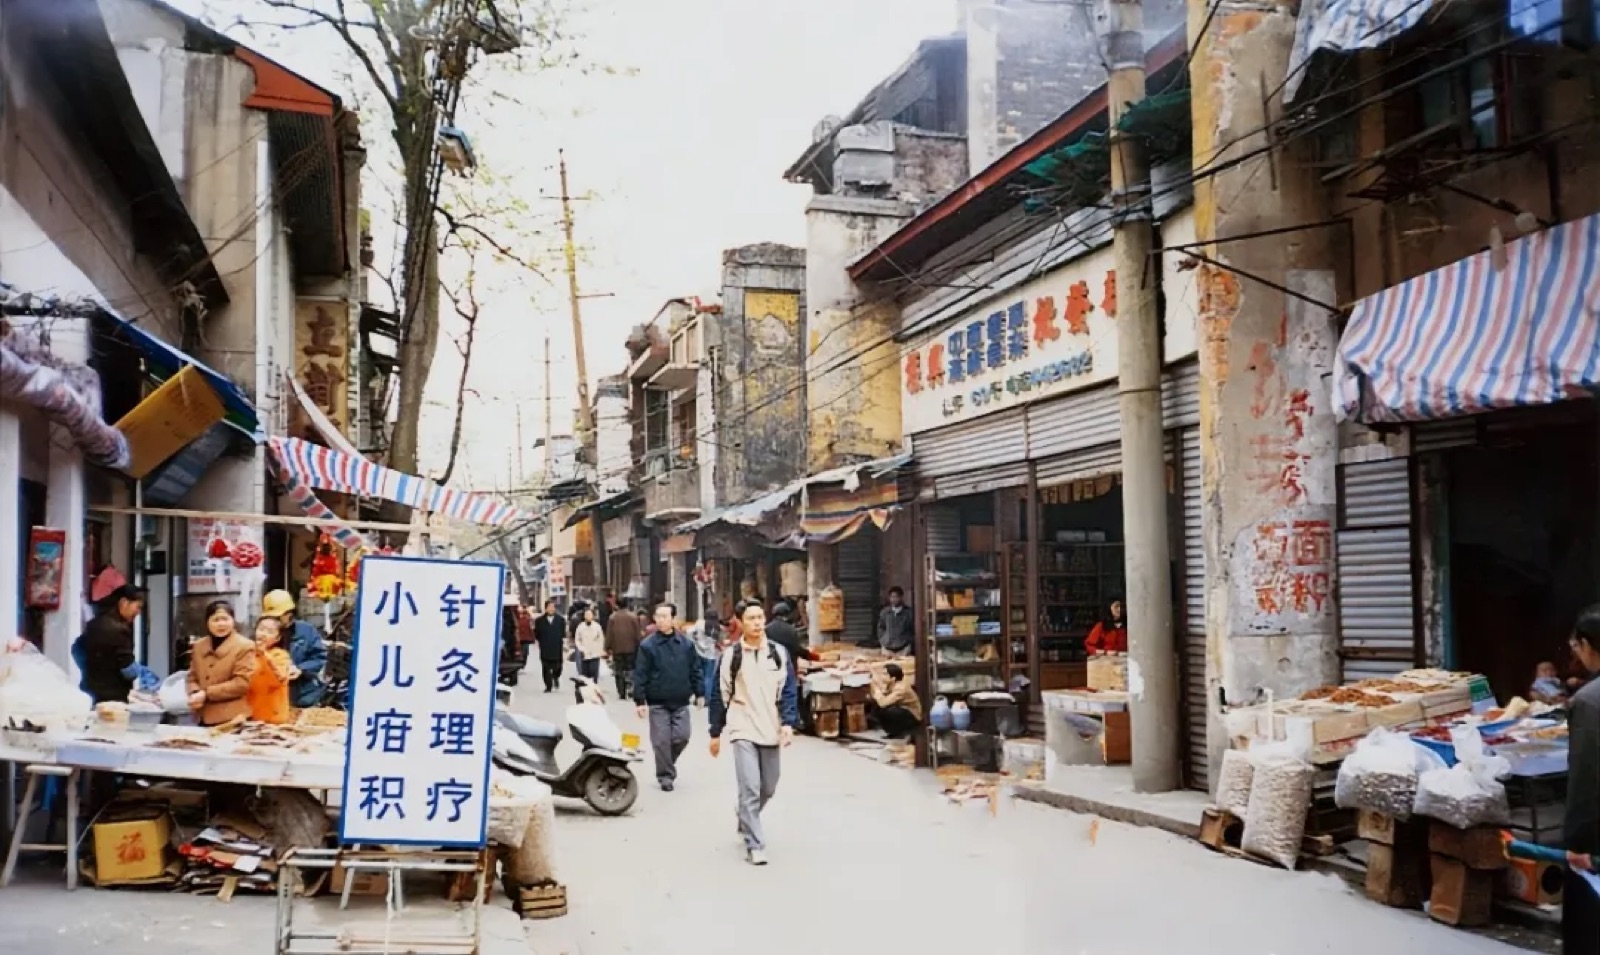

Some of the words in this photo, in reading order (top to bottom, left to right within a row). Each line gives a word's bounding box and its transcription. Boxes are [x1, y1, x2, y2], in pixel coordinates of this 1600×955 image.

[359, 581, 418, 820] 小儿疳积
[426, 584, 486, 822] 针灸理疗
